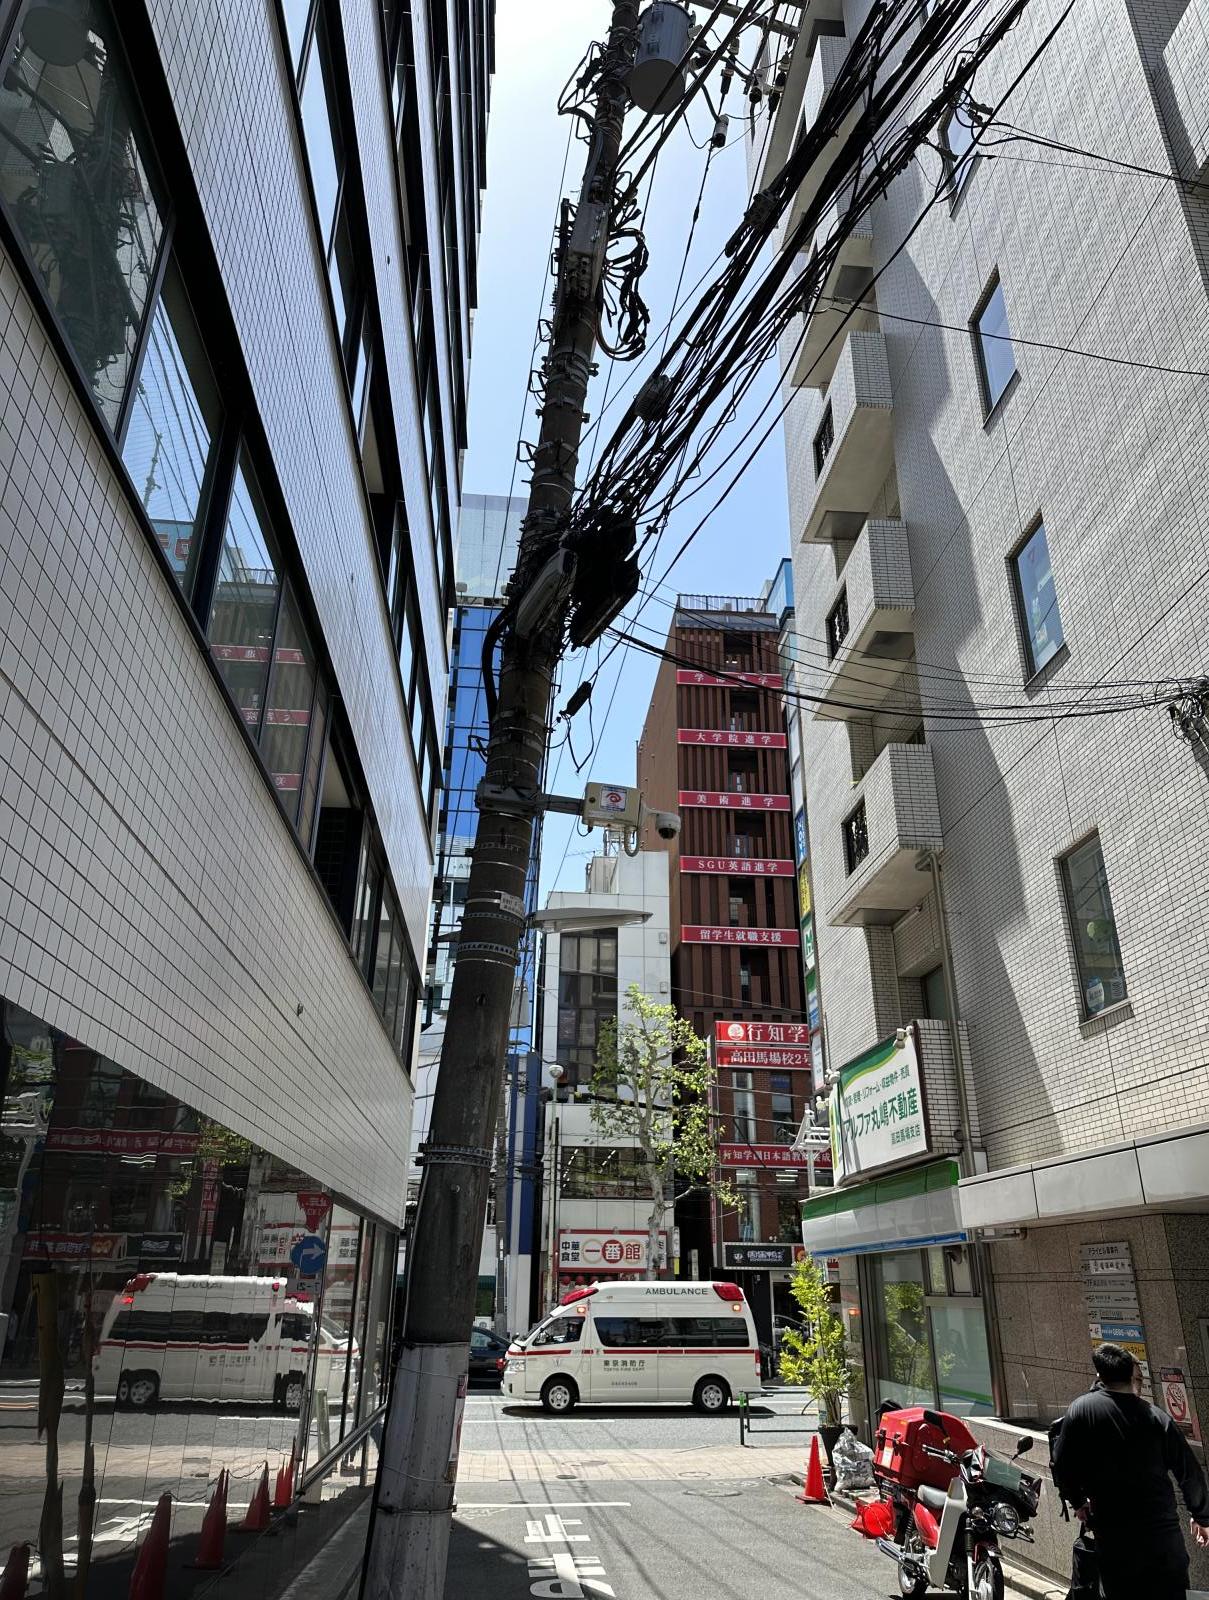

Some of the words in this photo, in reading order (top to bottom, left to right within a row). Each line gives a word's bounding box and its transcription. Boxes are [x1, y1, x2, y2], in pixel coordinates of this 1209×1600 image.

[696, 732, 771, 745] 大学院進学
[697, 794, 774, 807] 美術進学
[698, 861, 778, 873] SGU英語進学
[700, 930, 782, 943] 留学生就職支援
[561, 1241, 580, 1251] 中華
[585, 1243, 640, 1260] 一番館
[561, 1252, 580, 1262] 食堂
